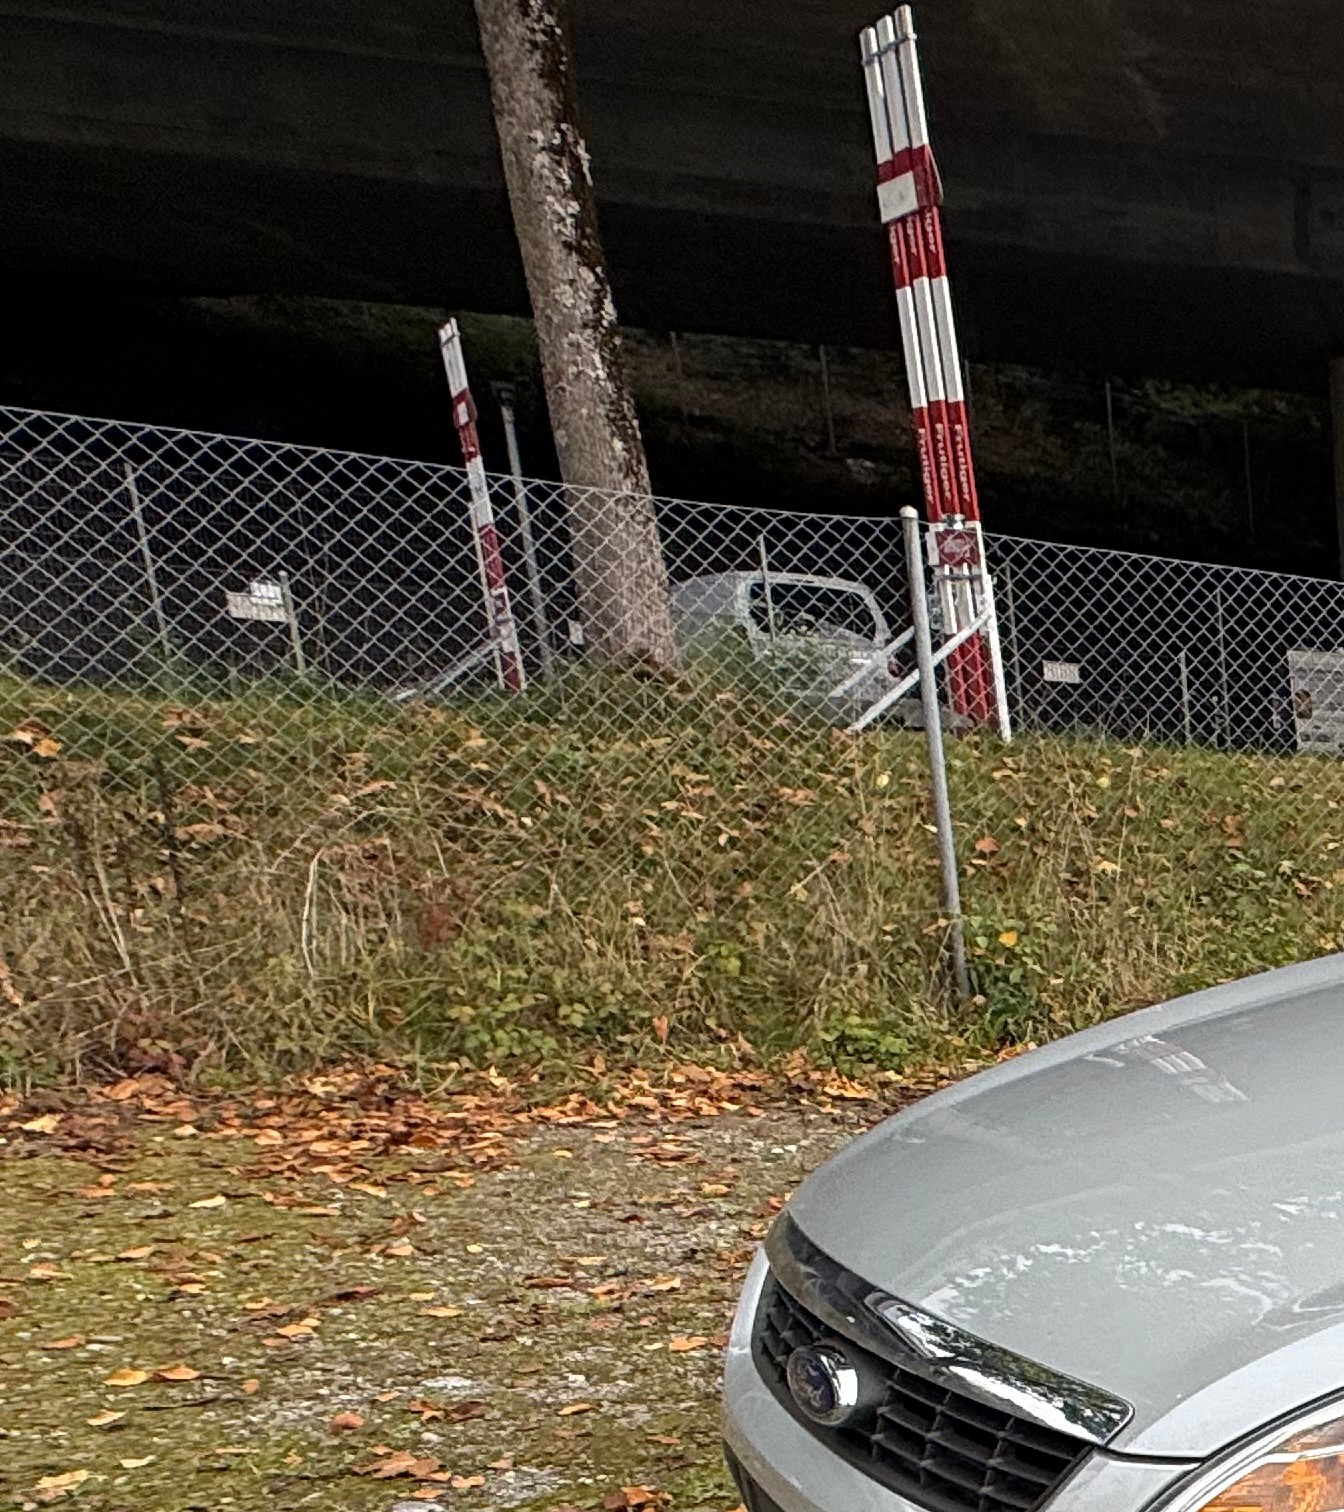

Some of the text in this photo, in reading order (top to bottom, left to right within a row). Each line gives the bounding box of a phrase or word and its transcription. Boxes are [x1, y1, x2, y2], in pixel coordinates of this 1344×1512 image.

[918, 428, 934, 504] Frutiger
[935, 423, 952, 500] Frutiger
[954, 424, 971, 502] Frutiger
